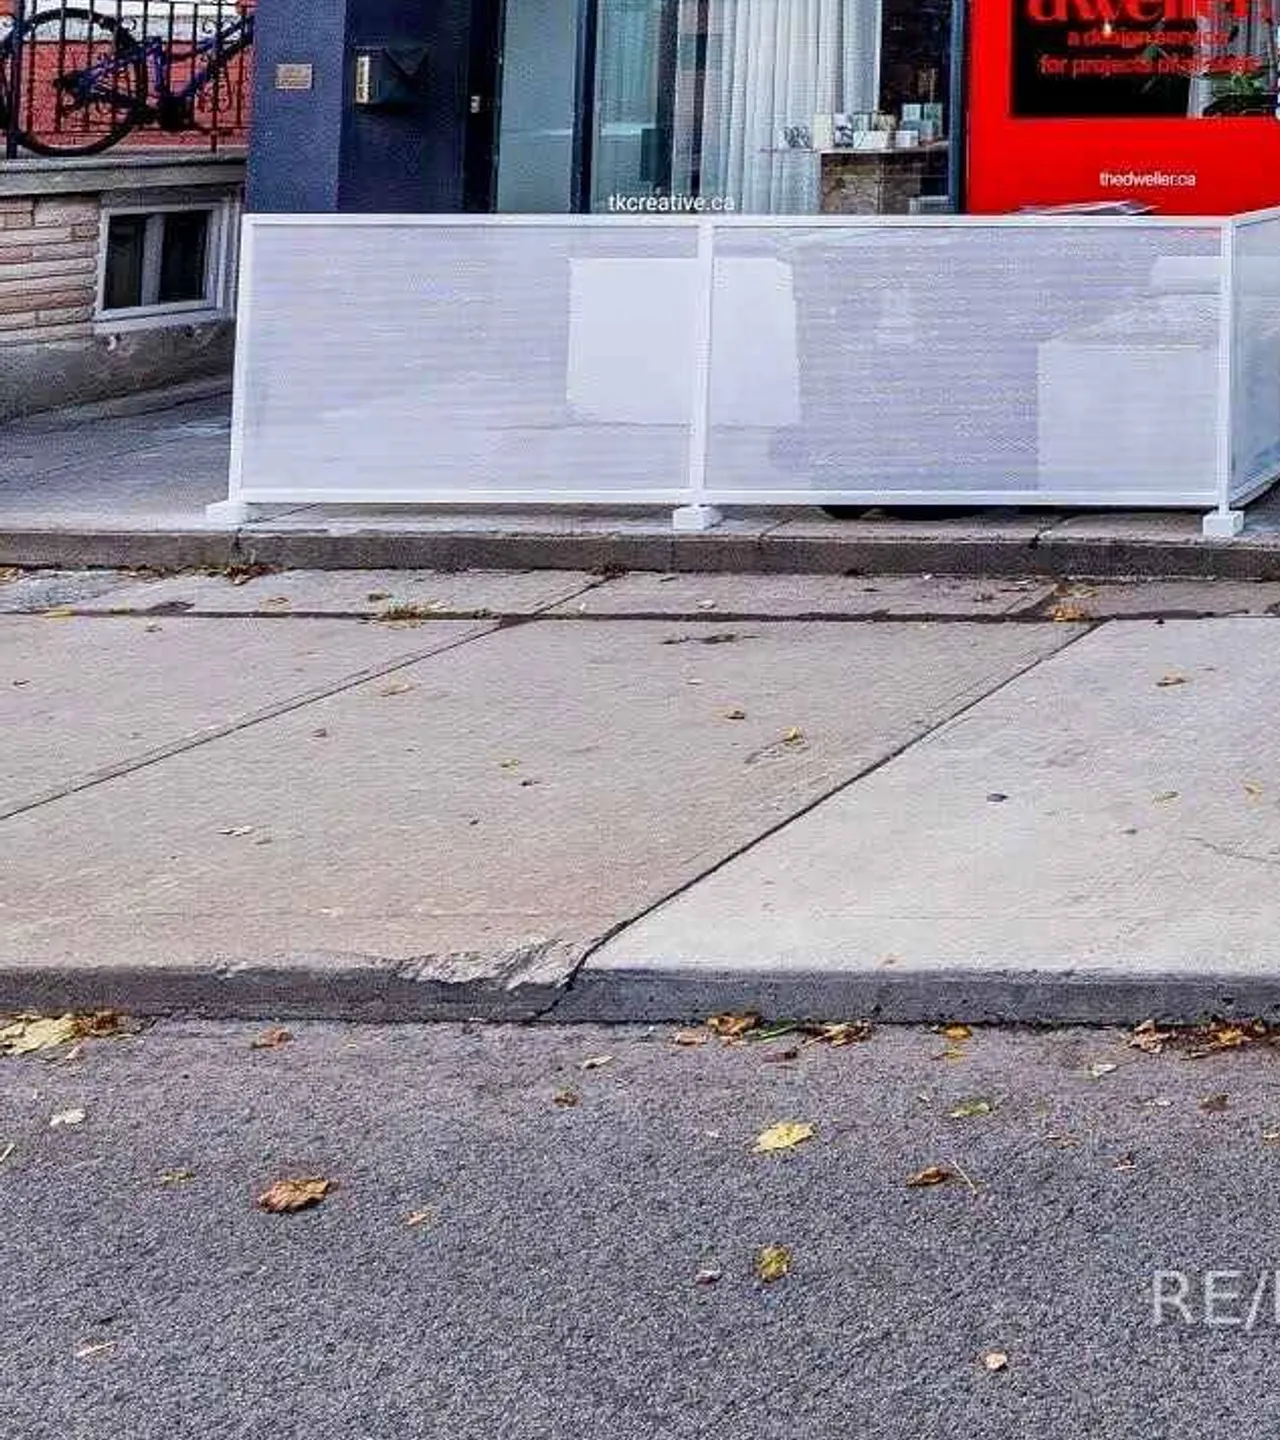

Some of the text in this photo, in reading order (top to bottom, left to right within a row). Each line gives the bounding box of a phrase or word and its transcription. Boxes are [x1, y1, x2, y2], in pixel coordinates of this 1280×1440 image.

[1039, 53, 1068, 74] for
[1099, 170, 1197, 188] thedweller.ca
[608, 193, 736, 212] tkcreative.ca
